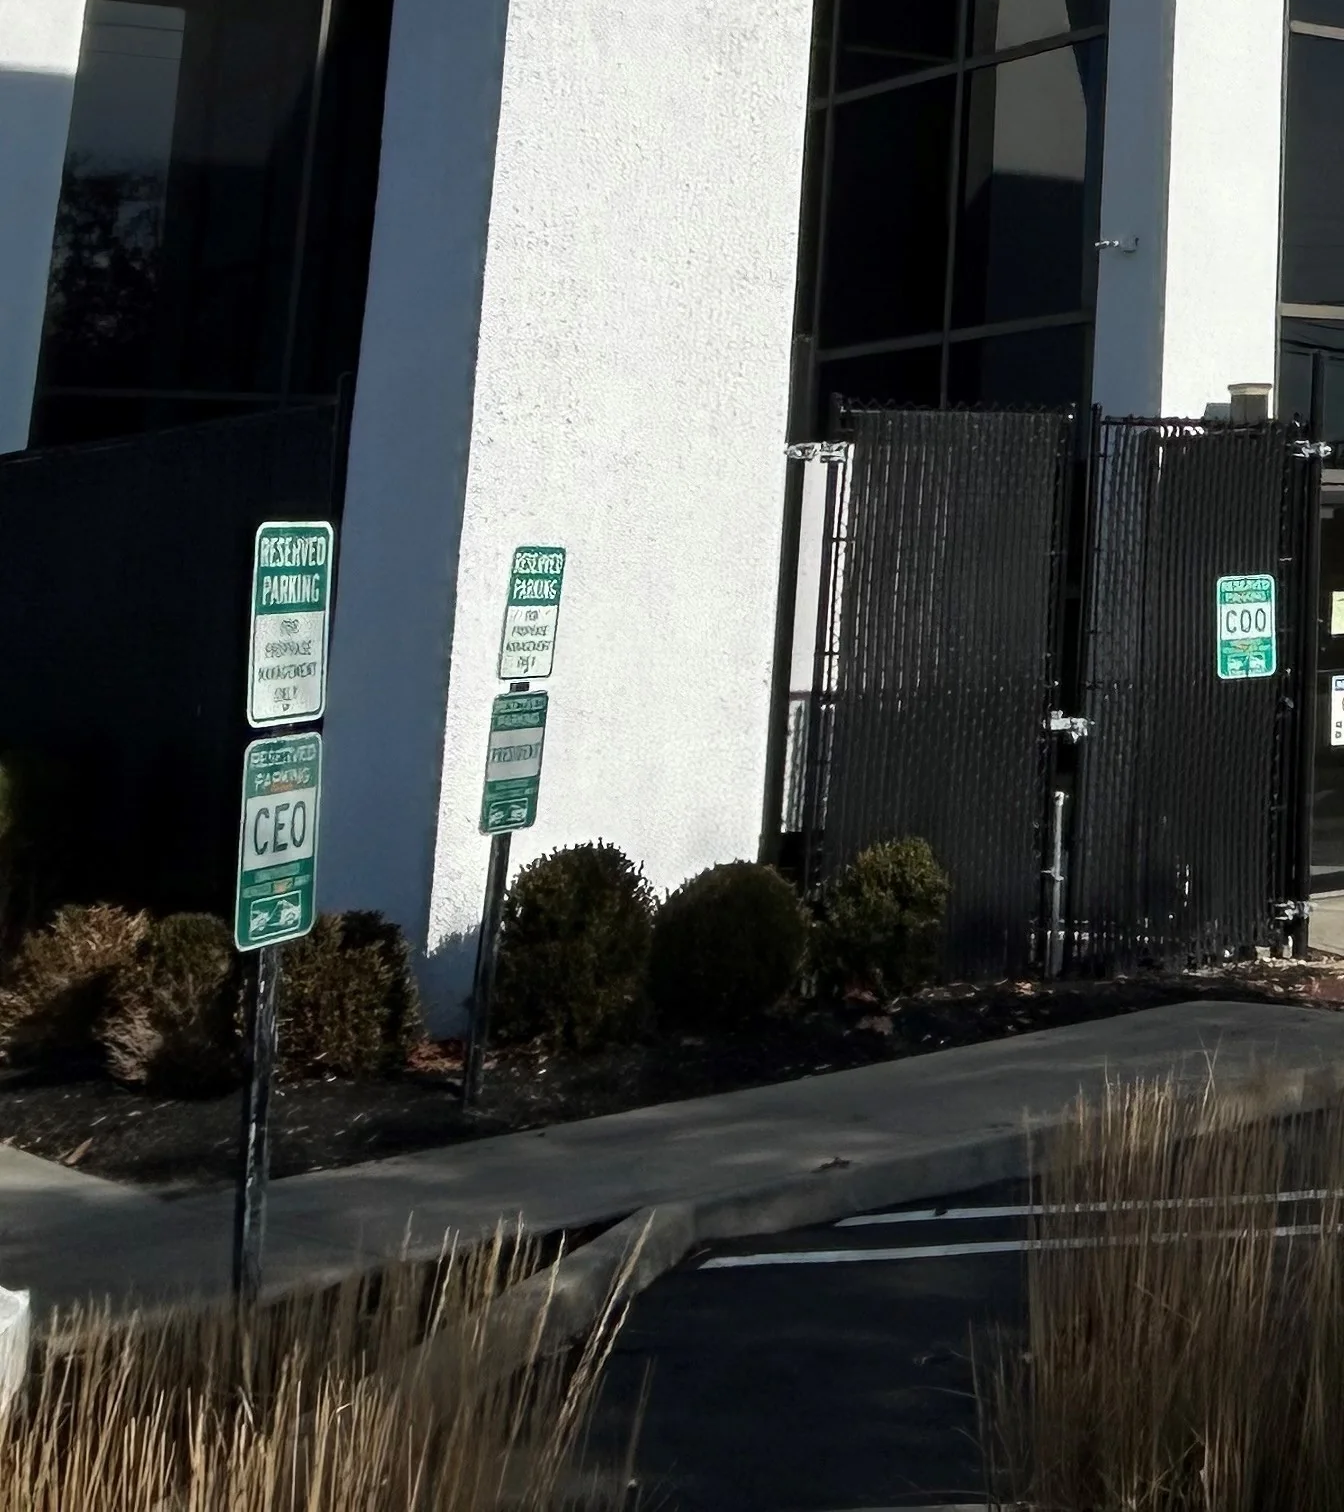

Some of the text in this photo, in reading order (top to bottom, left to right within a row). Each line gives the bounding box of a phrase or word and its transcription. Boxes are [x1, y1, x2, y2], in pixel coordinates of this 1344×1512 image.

[260, 536, 326, 568] RESERVED
[262, 573, 320, 606] PARKING
[1225, 608, 1267, 634] COO
[253, 800, 307, 856] CEO
